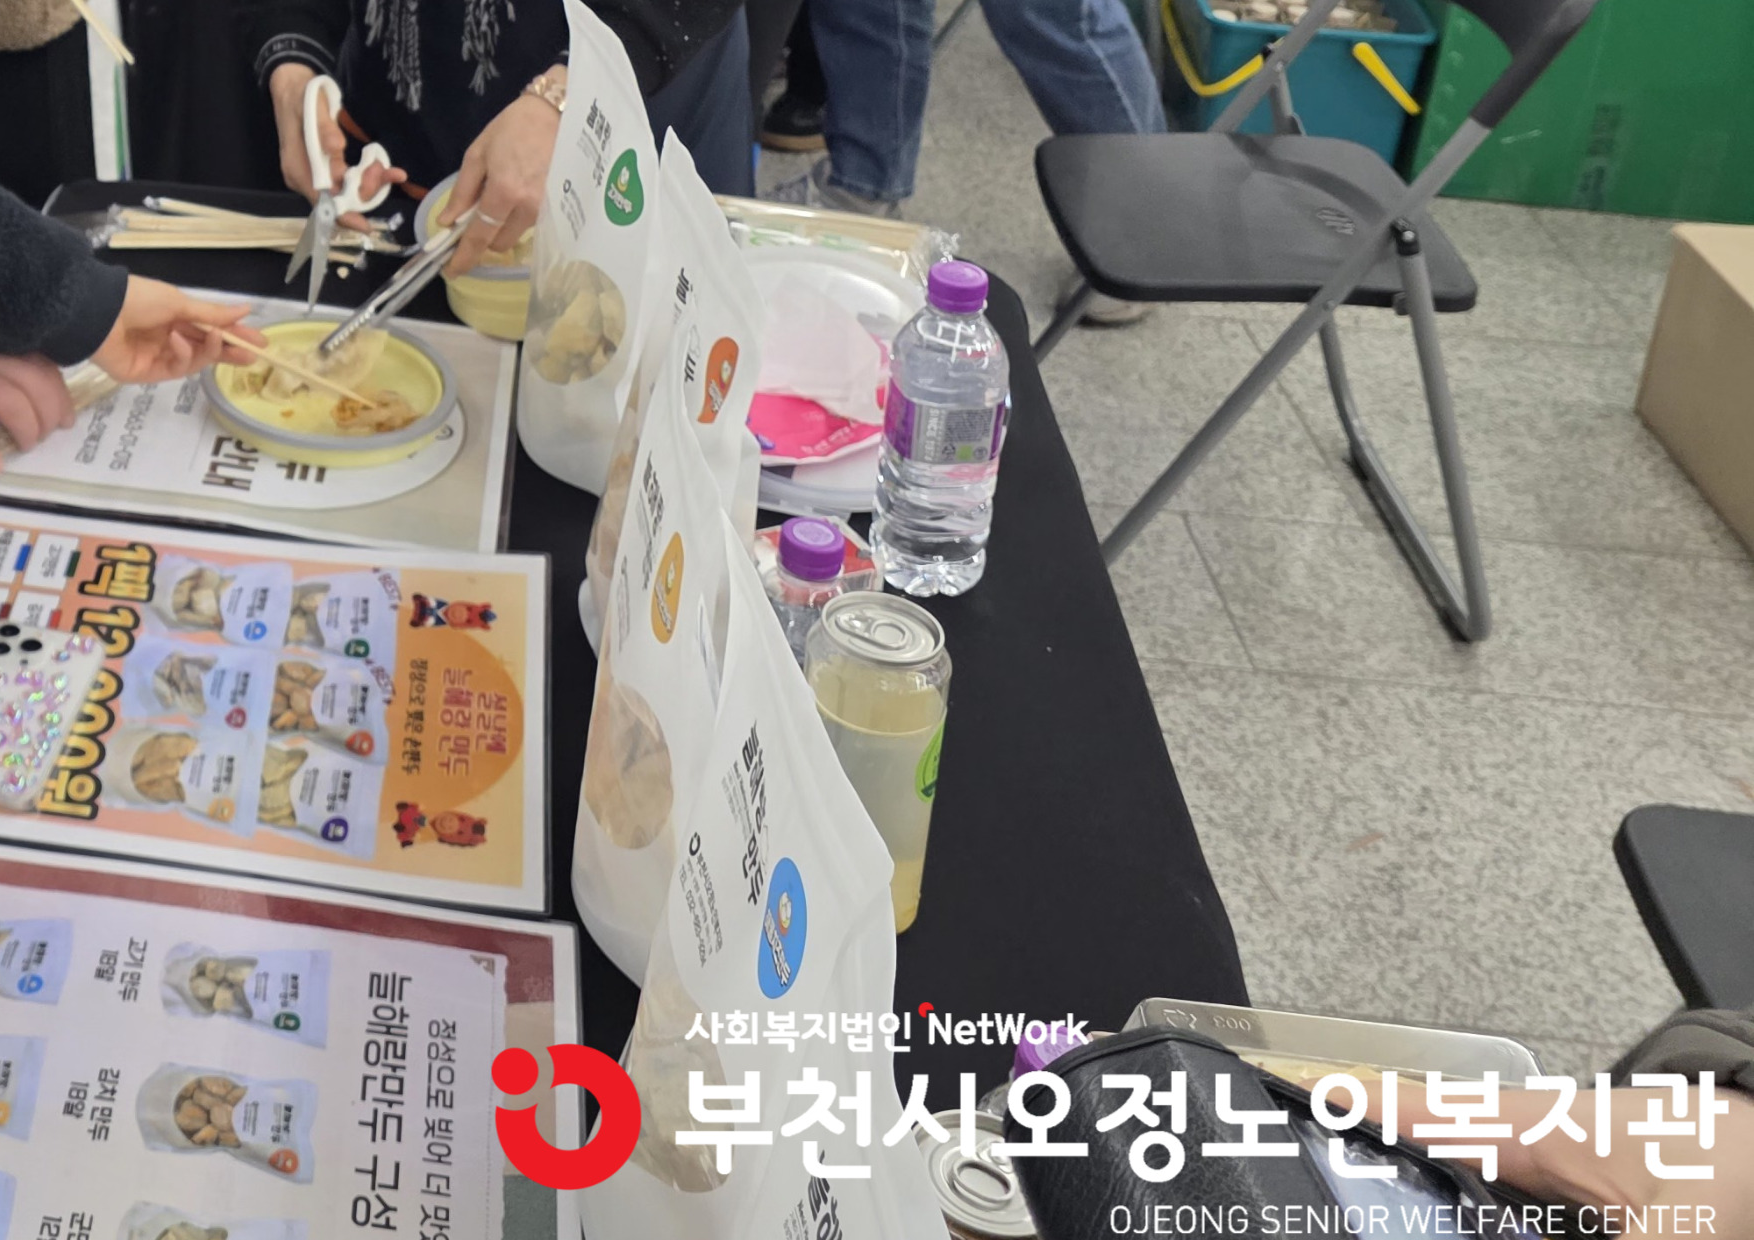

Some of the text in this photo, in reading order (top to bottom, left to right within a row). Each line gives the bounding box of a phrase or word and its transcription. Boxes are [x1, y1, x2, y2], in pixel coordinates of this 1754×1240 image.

[79, 543, 157, 603] 1팩
[438, 668, 473, 777] 늘해랑 만두
[742, 720, 766, 834] 늘해랑
[743, 829, 764, 905] 만두
[94, 949, 119, 982] 18알
[118, 937, 148, 1002] 고기 만두
[425, 1017, 457, 1109] 정성으로
[62, 1080, 90, 1118] 18알
[87, 1067, 121, 1142] 김치 만두
[350, 971, 413, 1231] 늘해랑만두 구성
[422, 1117, 453, 1166] 빚어
[421, 1172, 452, 1197] 더
